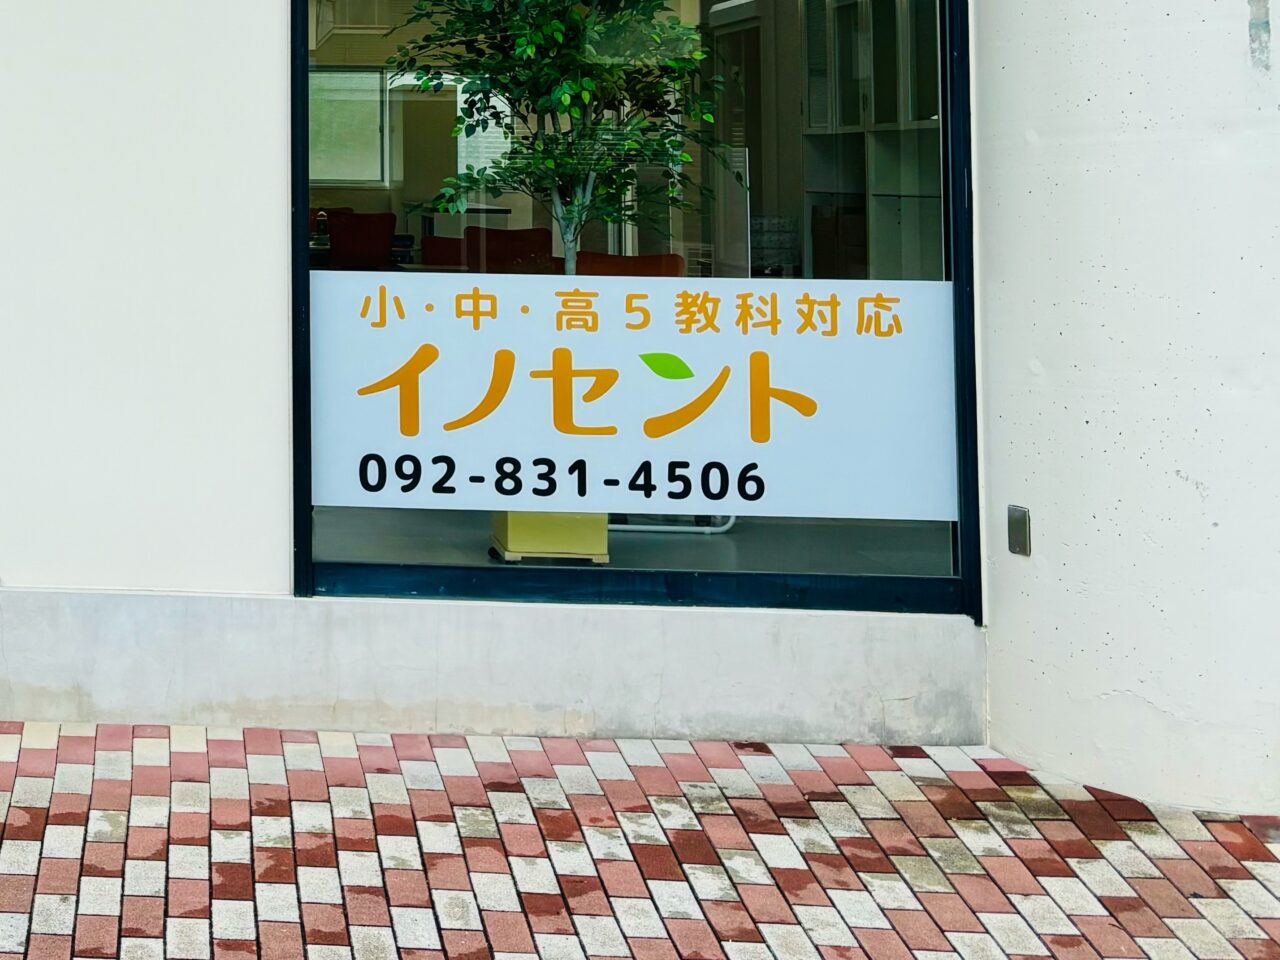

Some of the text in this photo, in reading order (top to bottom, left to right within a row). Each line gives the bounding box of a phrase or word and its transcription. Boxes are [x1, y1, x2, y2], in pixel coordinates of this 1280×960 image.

[356, 343, 819, 444] イノセント
[358, 453, 766, 502] 092-831-4506
